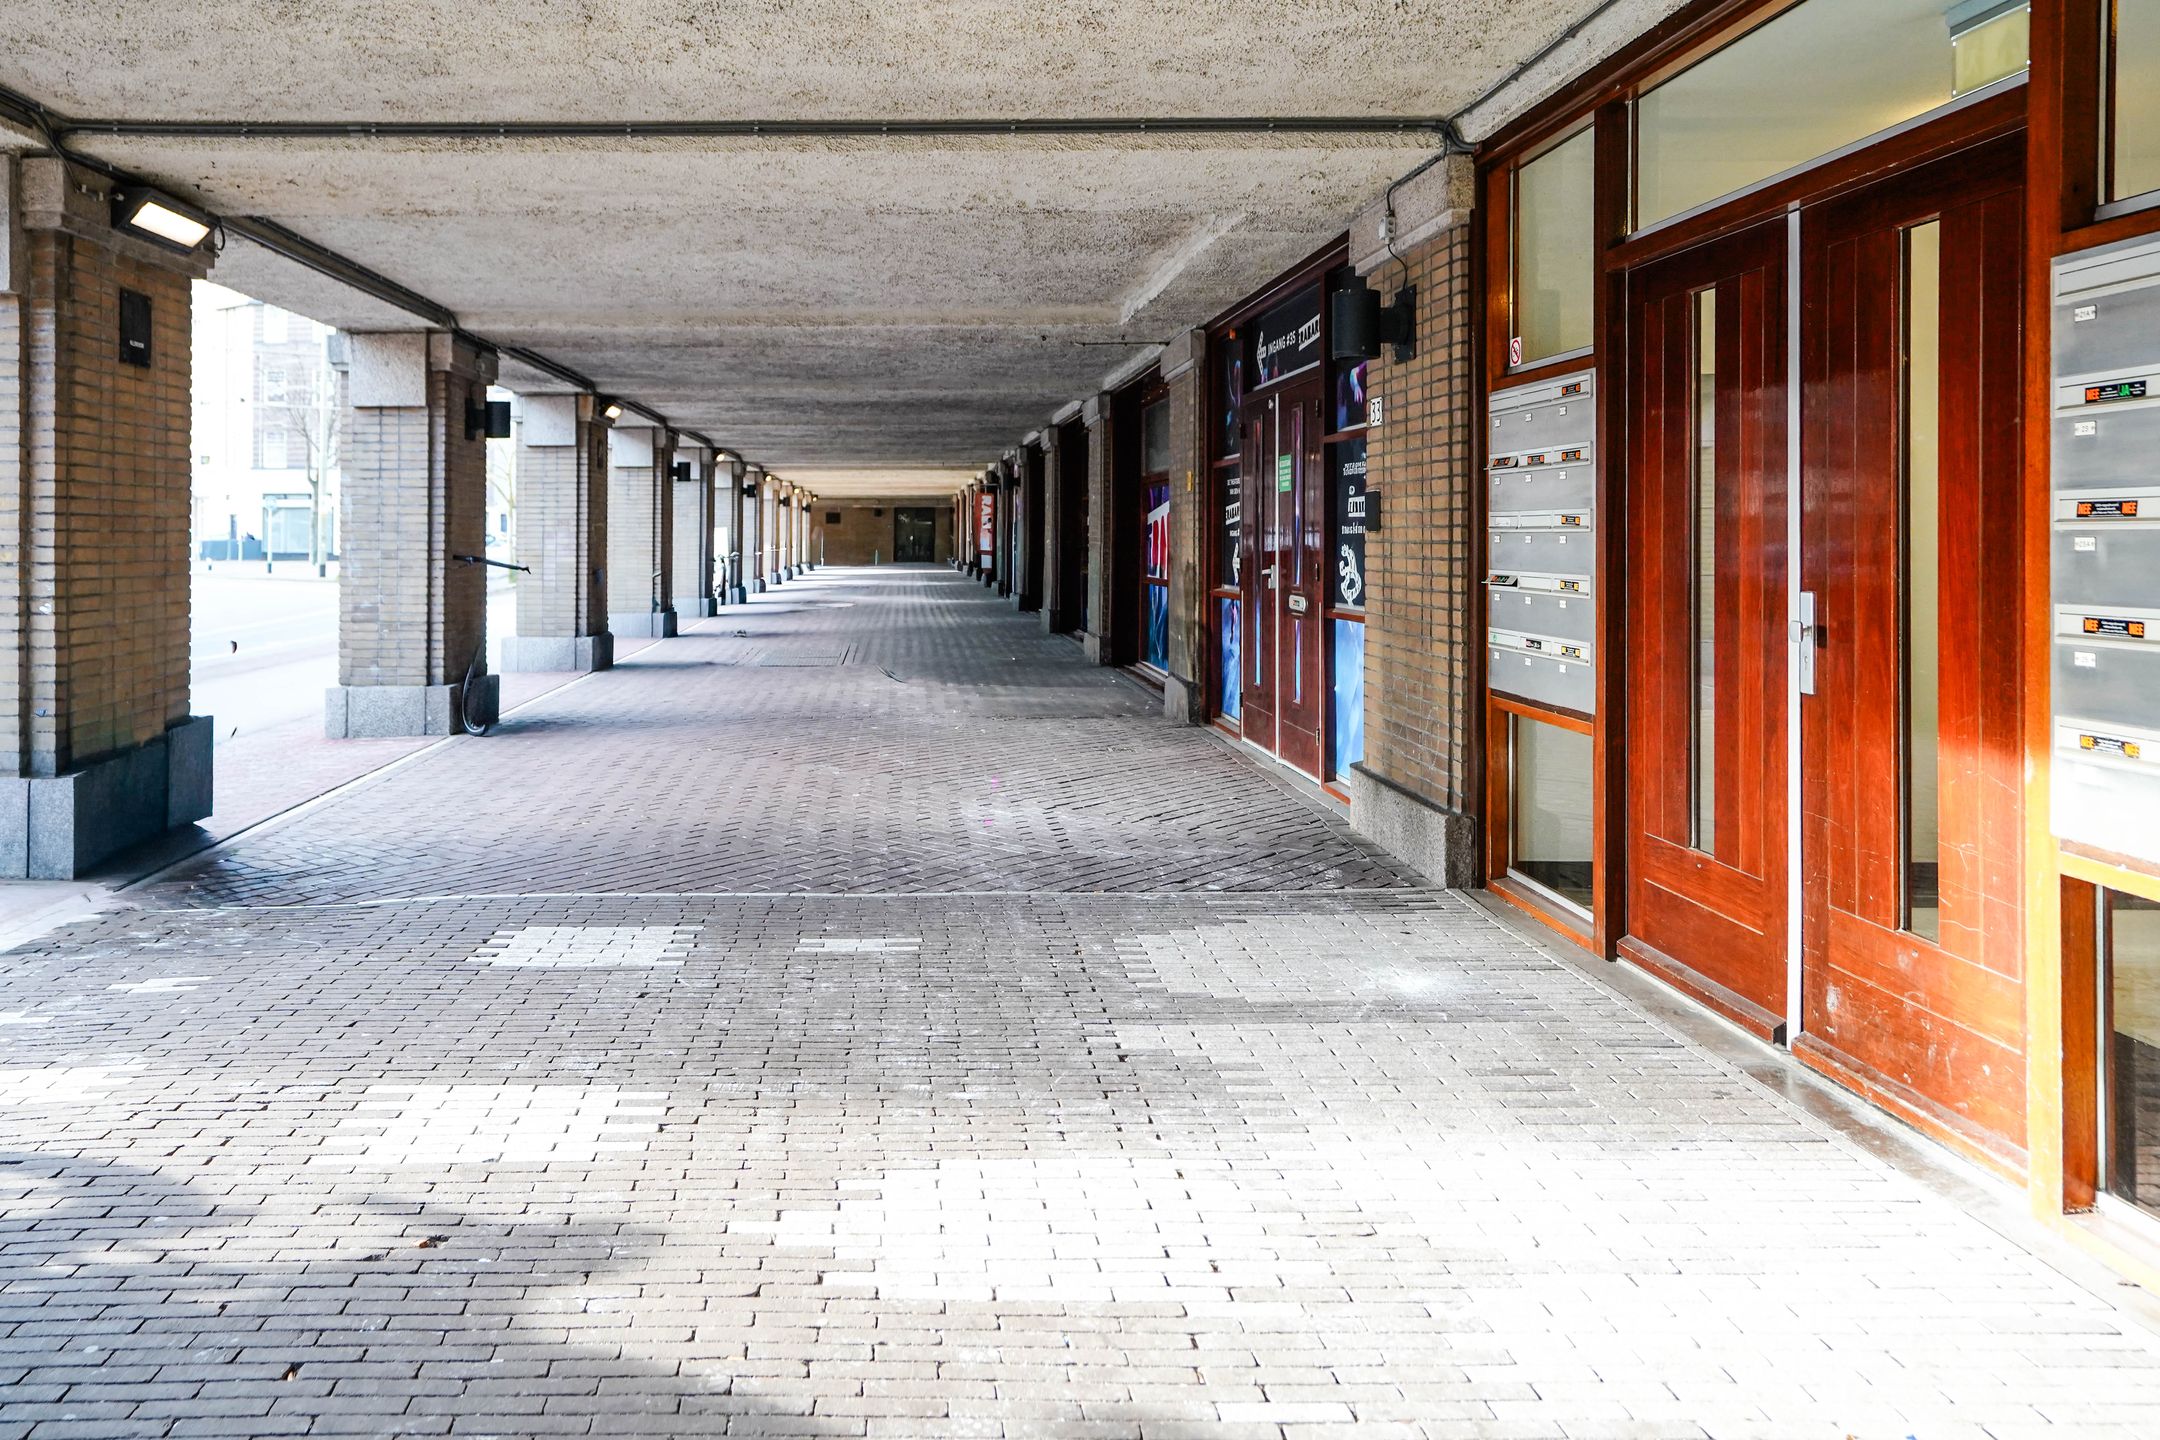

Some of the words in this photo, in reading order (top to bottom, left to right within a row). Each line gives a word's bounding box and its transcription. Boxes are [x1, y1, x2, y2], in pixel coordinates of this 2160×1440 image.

[1268, 335, 1286, 354] INGANG
[2086, 388, 2100, 401] NEE
[2119, 384, 2131, 397] JA
[1372, 401, 1381, 423] 33
[2078, 503, 2092, 515] NEE
[2122, 502, 2136, 514] NEE
[2084, 619, 2099, 631] NEE
[2129, 622, 2143, 635] NEE
[2081, 736, 2095, 749] NEE
